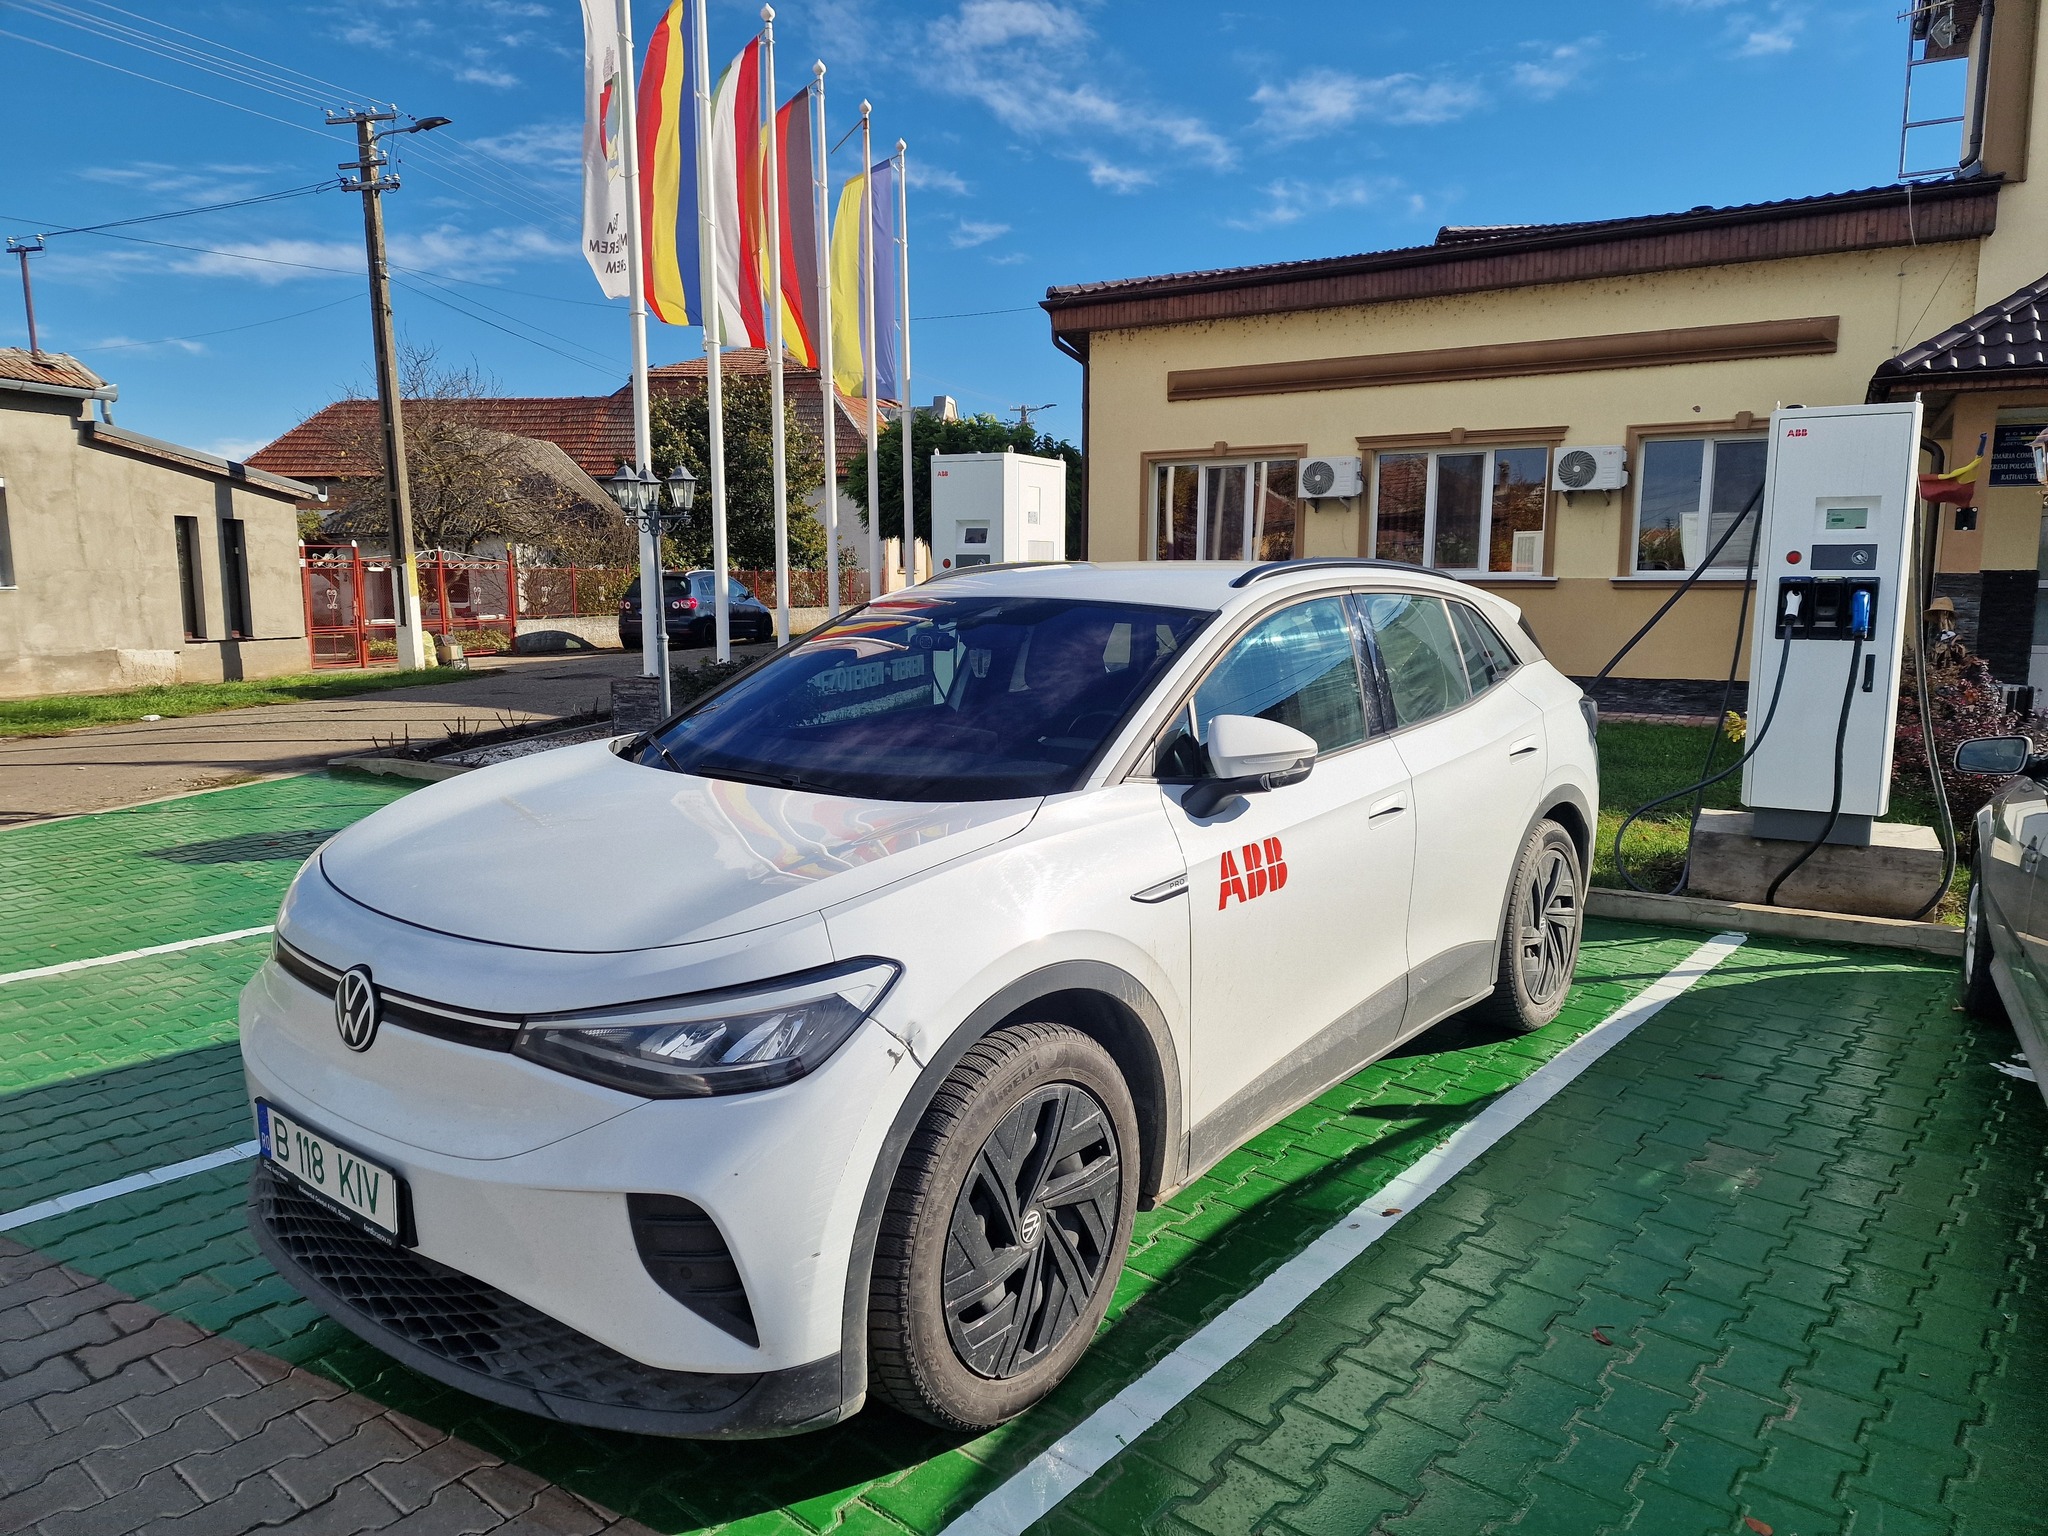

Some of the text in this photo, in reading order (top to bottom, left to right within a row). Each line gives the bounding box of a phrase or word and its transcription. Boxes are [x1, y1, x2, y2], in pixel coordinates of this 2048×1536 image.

[1787, 428, 1808, 437] ABB
[1218, 836, 1288, 911] ABB
[1169, 878, 1185, 890] PRO
[261, 1131, 271, 1151] RO
[273, 1115, 290, 1162] B
[295, 1131, 325, 1185] 118
[337, 1153, 379, 1215] KIV
